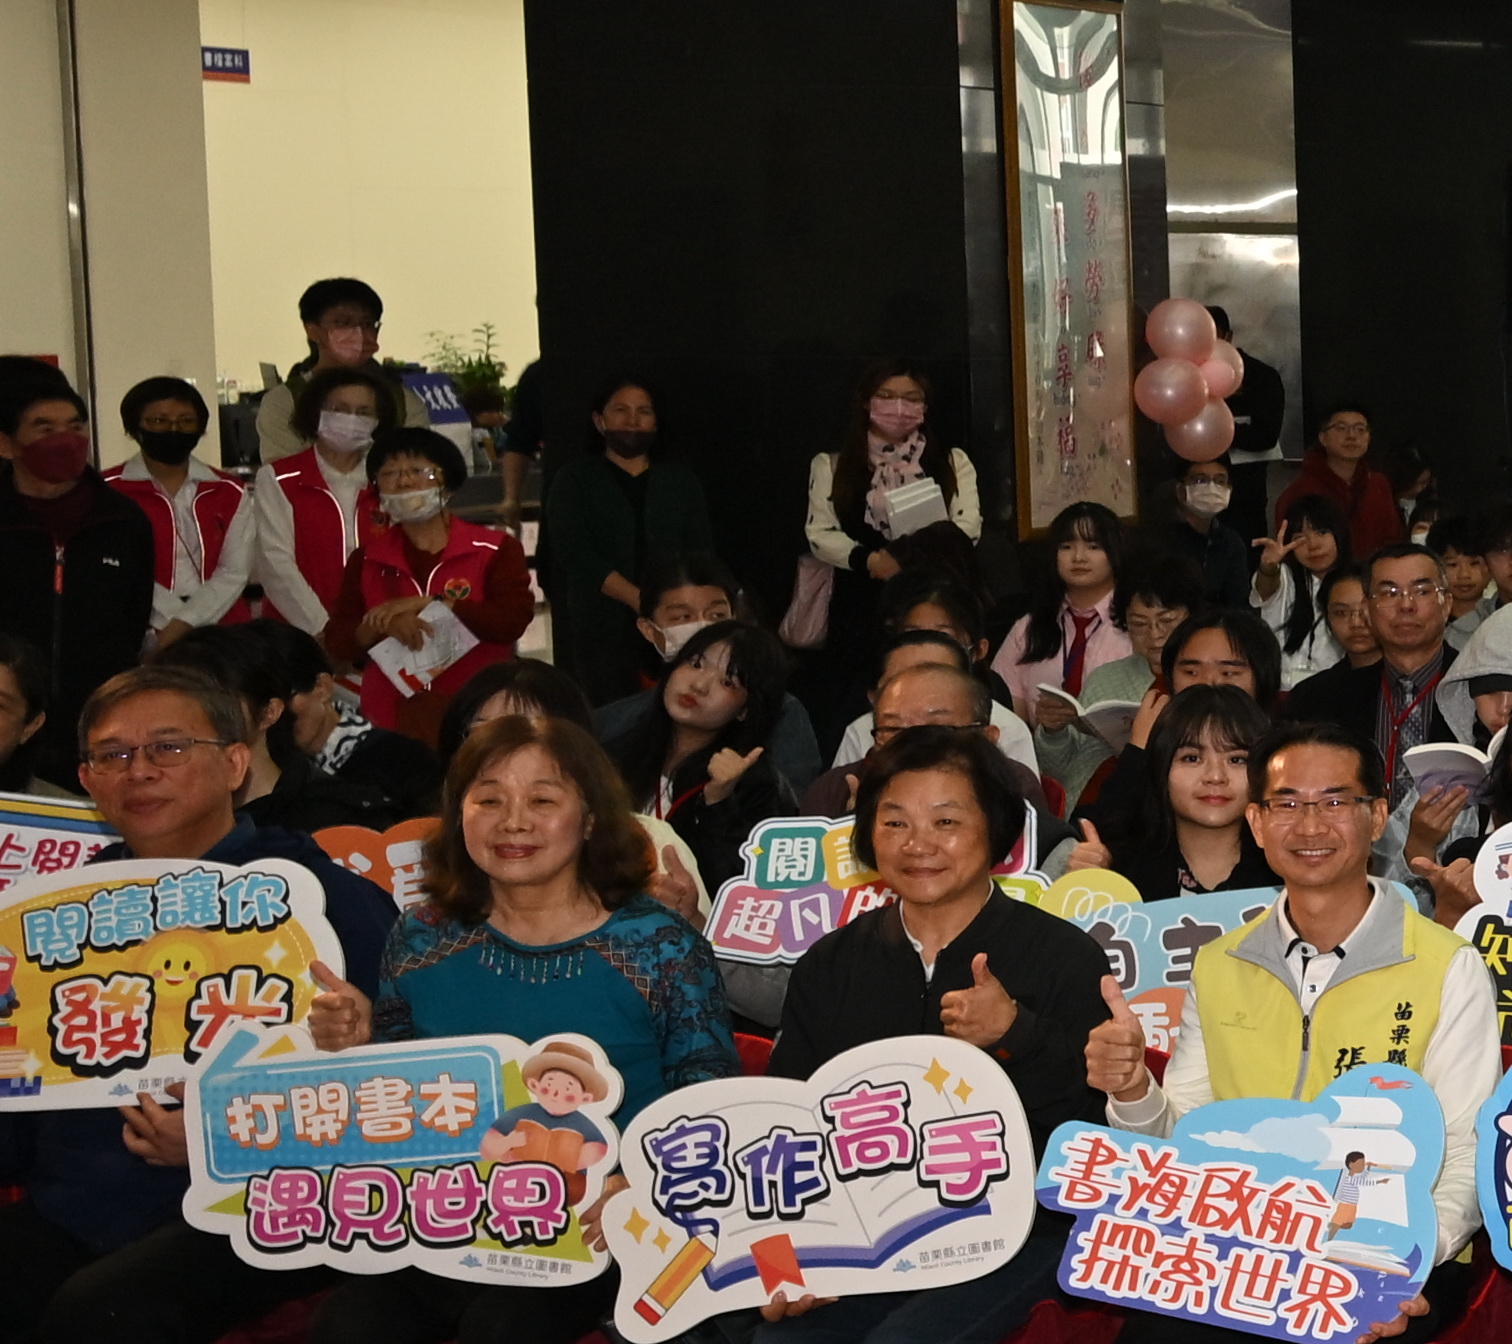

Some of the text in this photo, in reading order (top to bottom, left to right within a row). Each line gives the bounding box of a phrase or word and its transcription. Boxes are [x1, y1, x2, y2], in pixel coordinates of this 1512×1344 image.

[26, 870, 288, 966] 閱讀讓你
[56, 975, 286, 1063] 發光
[228, 1074, 480, 1151] 打開書本
[647, 1082, 1008, 1216] 寫作高手
[248, 1166, 568, 1247] 遇見世界
[1053, 1137, 1330, 1255] 書海啟航
[486, 1253, 573, 1275] 苗栗縣立圖書館
[919, 1239, 1006, 1264] 苗栗縣立圖書館
[1077, 1220, 1358, 1337] 探索世界
